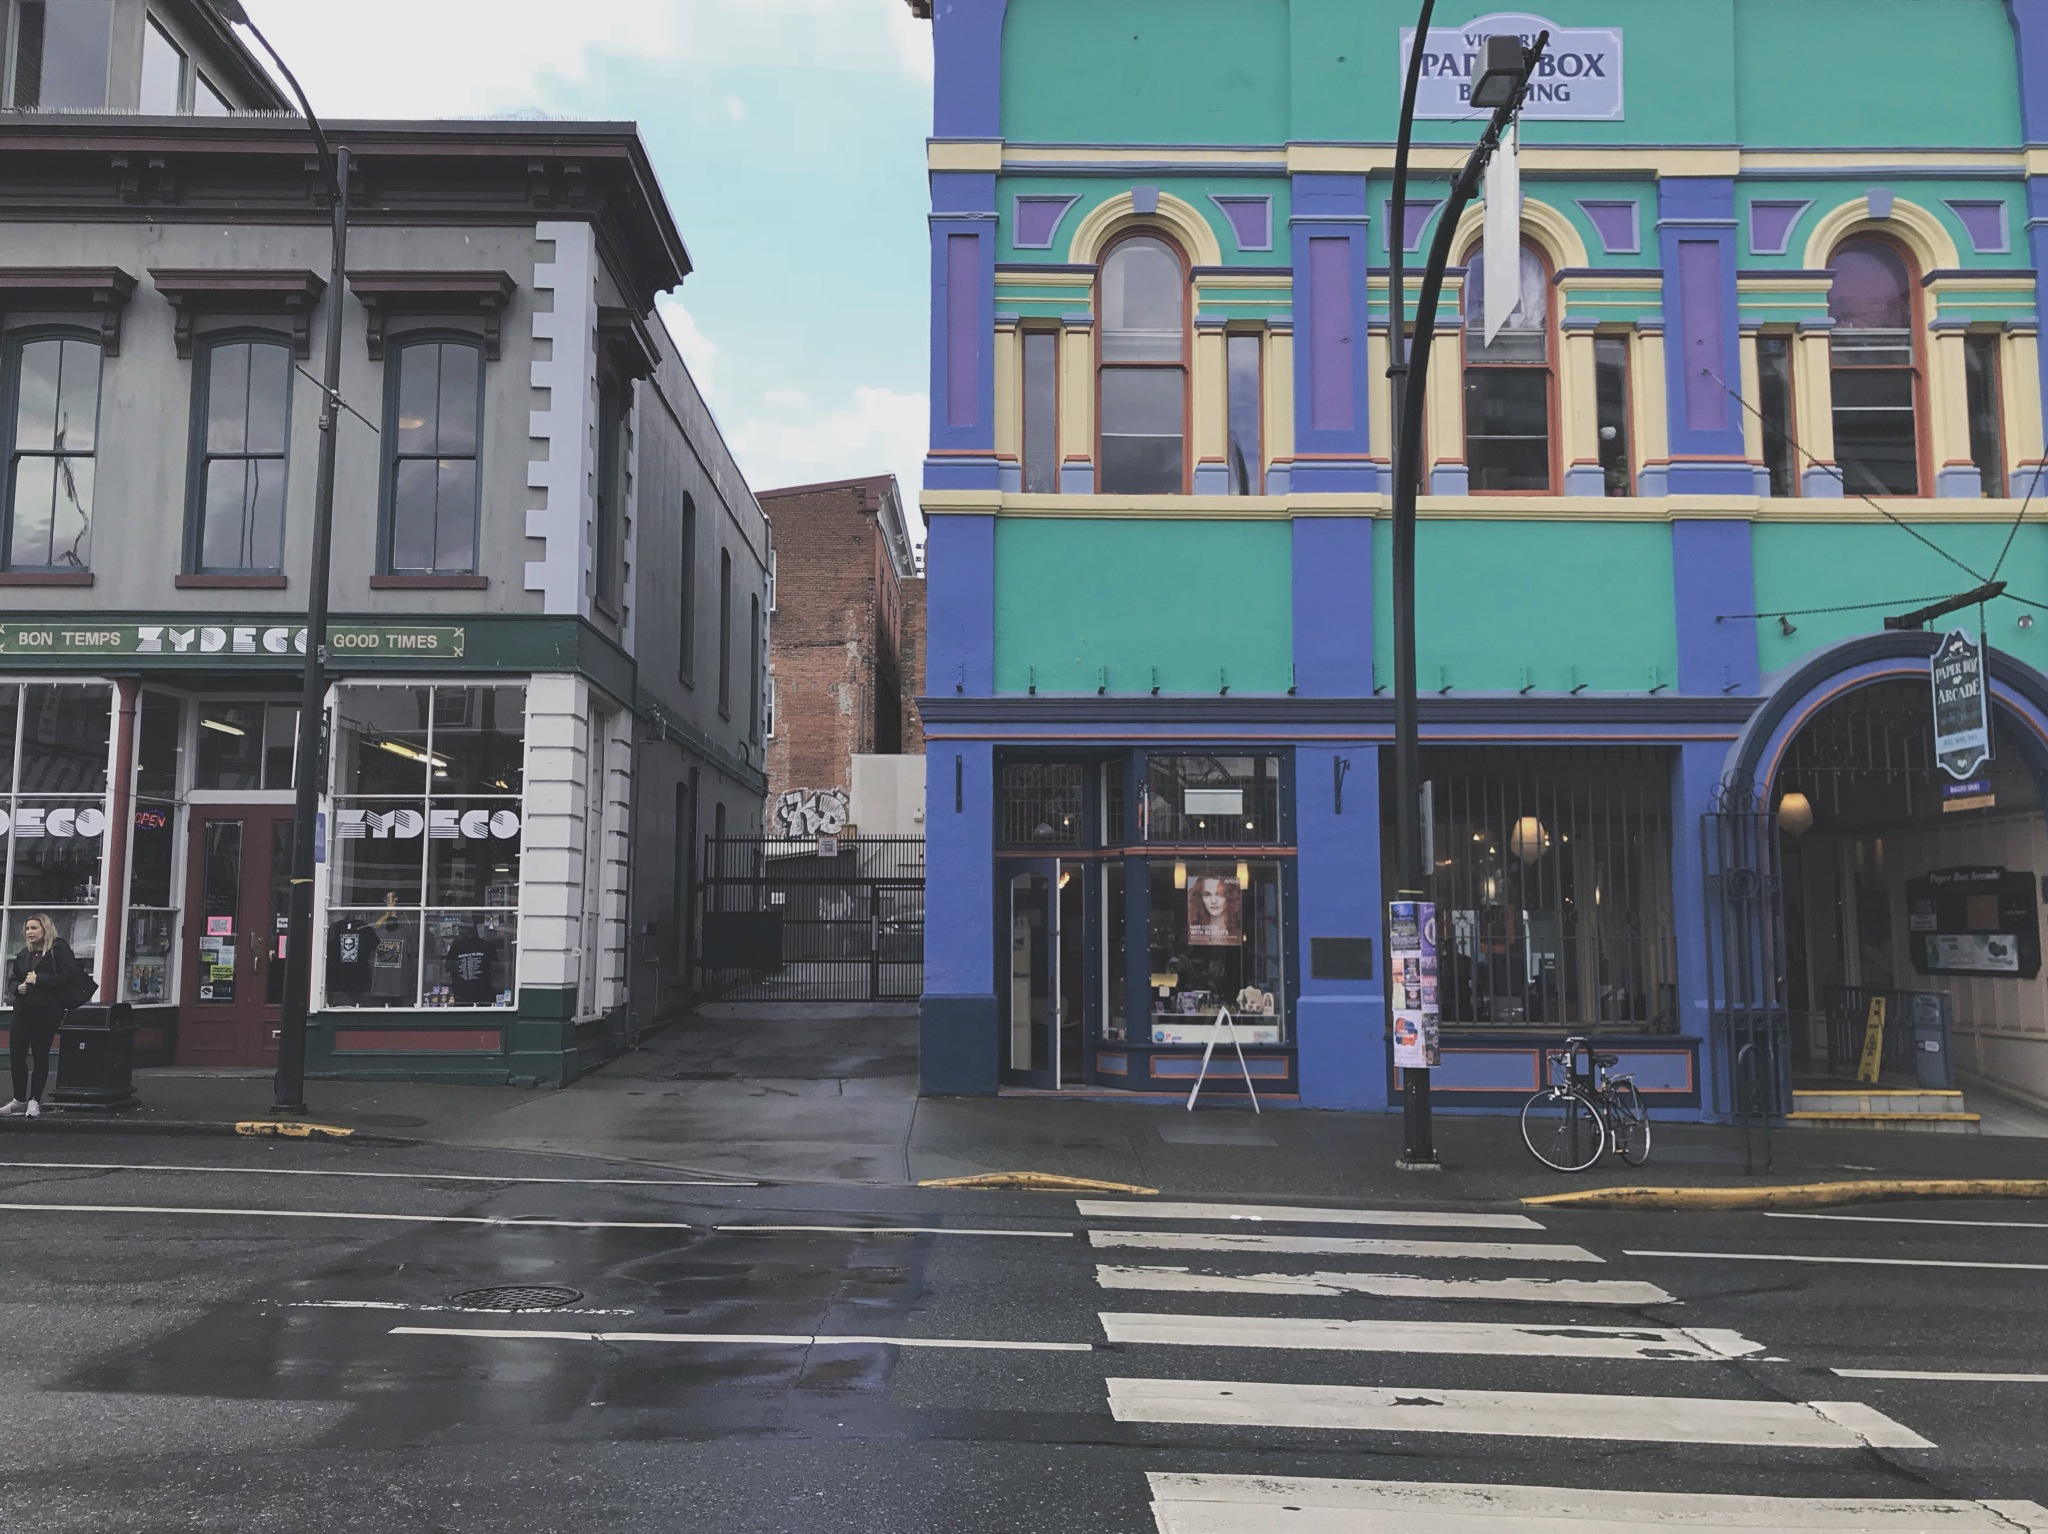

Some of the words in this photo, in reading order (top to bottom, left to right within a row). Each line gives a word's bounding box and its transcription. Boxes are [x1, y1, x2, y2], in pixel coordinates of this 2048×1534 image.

[1464, 33, 1551, 47] VIRI
[1538, 53, 1606, 78] BOX
[1459, 83, 1571, 102] BING
[18, 631, 53, 646] BON
[61, 631, 121, 646] TEMPS
[333, 634, 380, 648] GOOD
[385, 635, 438, 649] TIMES
[1935, 661, 1962, 684] PAPER
[1937, 678, 1981, 705] ARCADE
[134, 812, 166, 828] OPEN
[335, 809, 519, 839] ZYDECO
